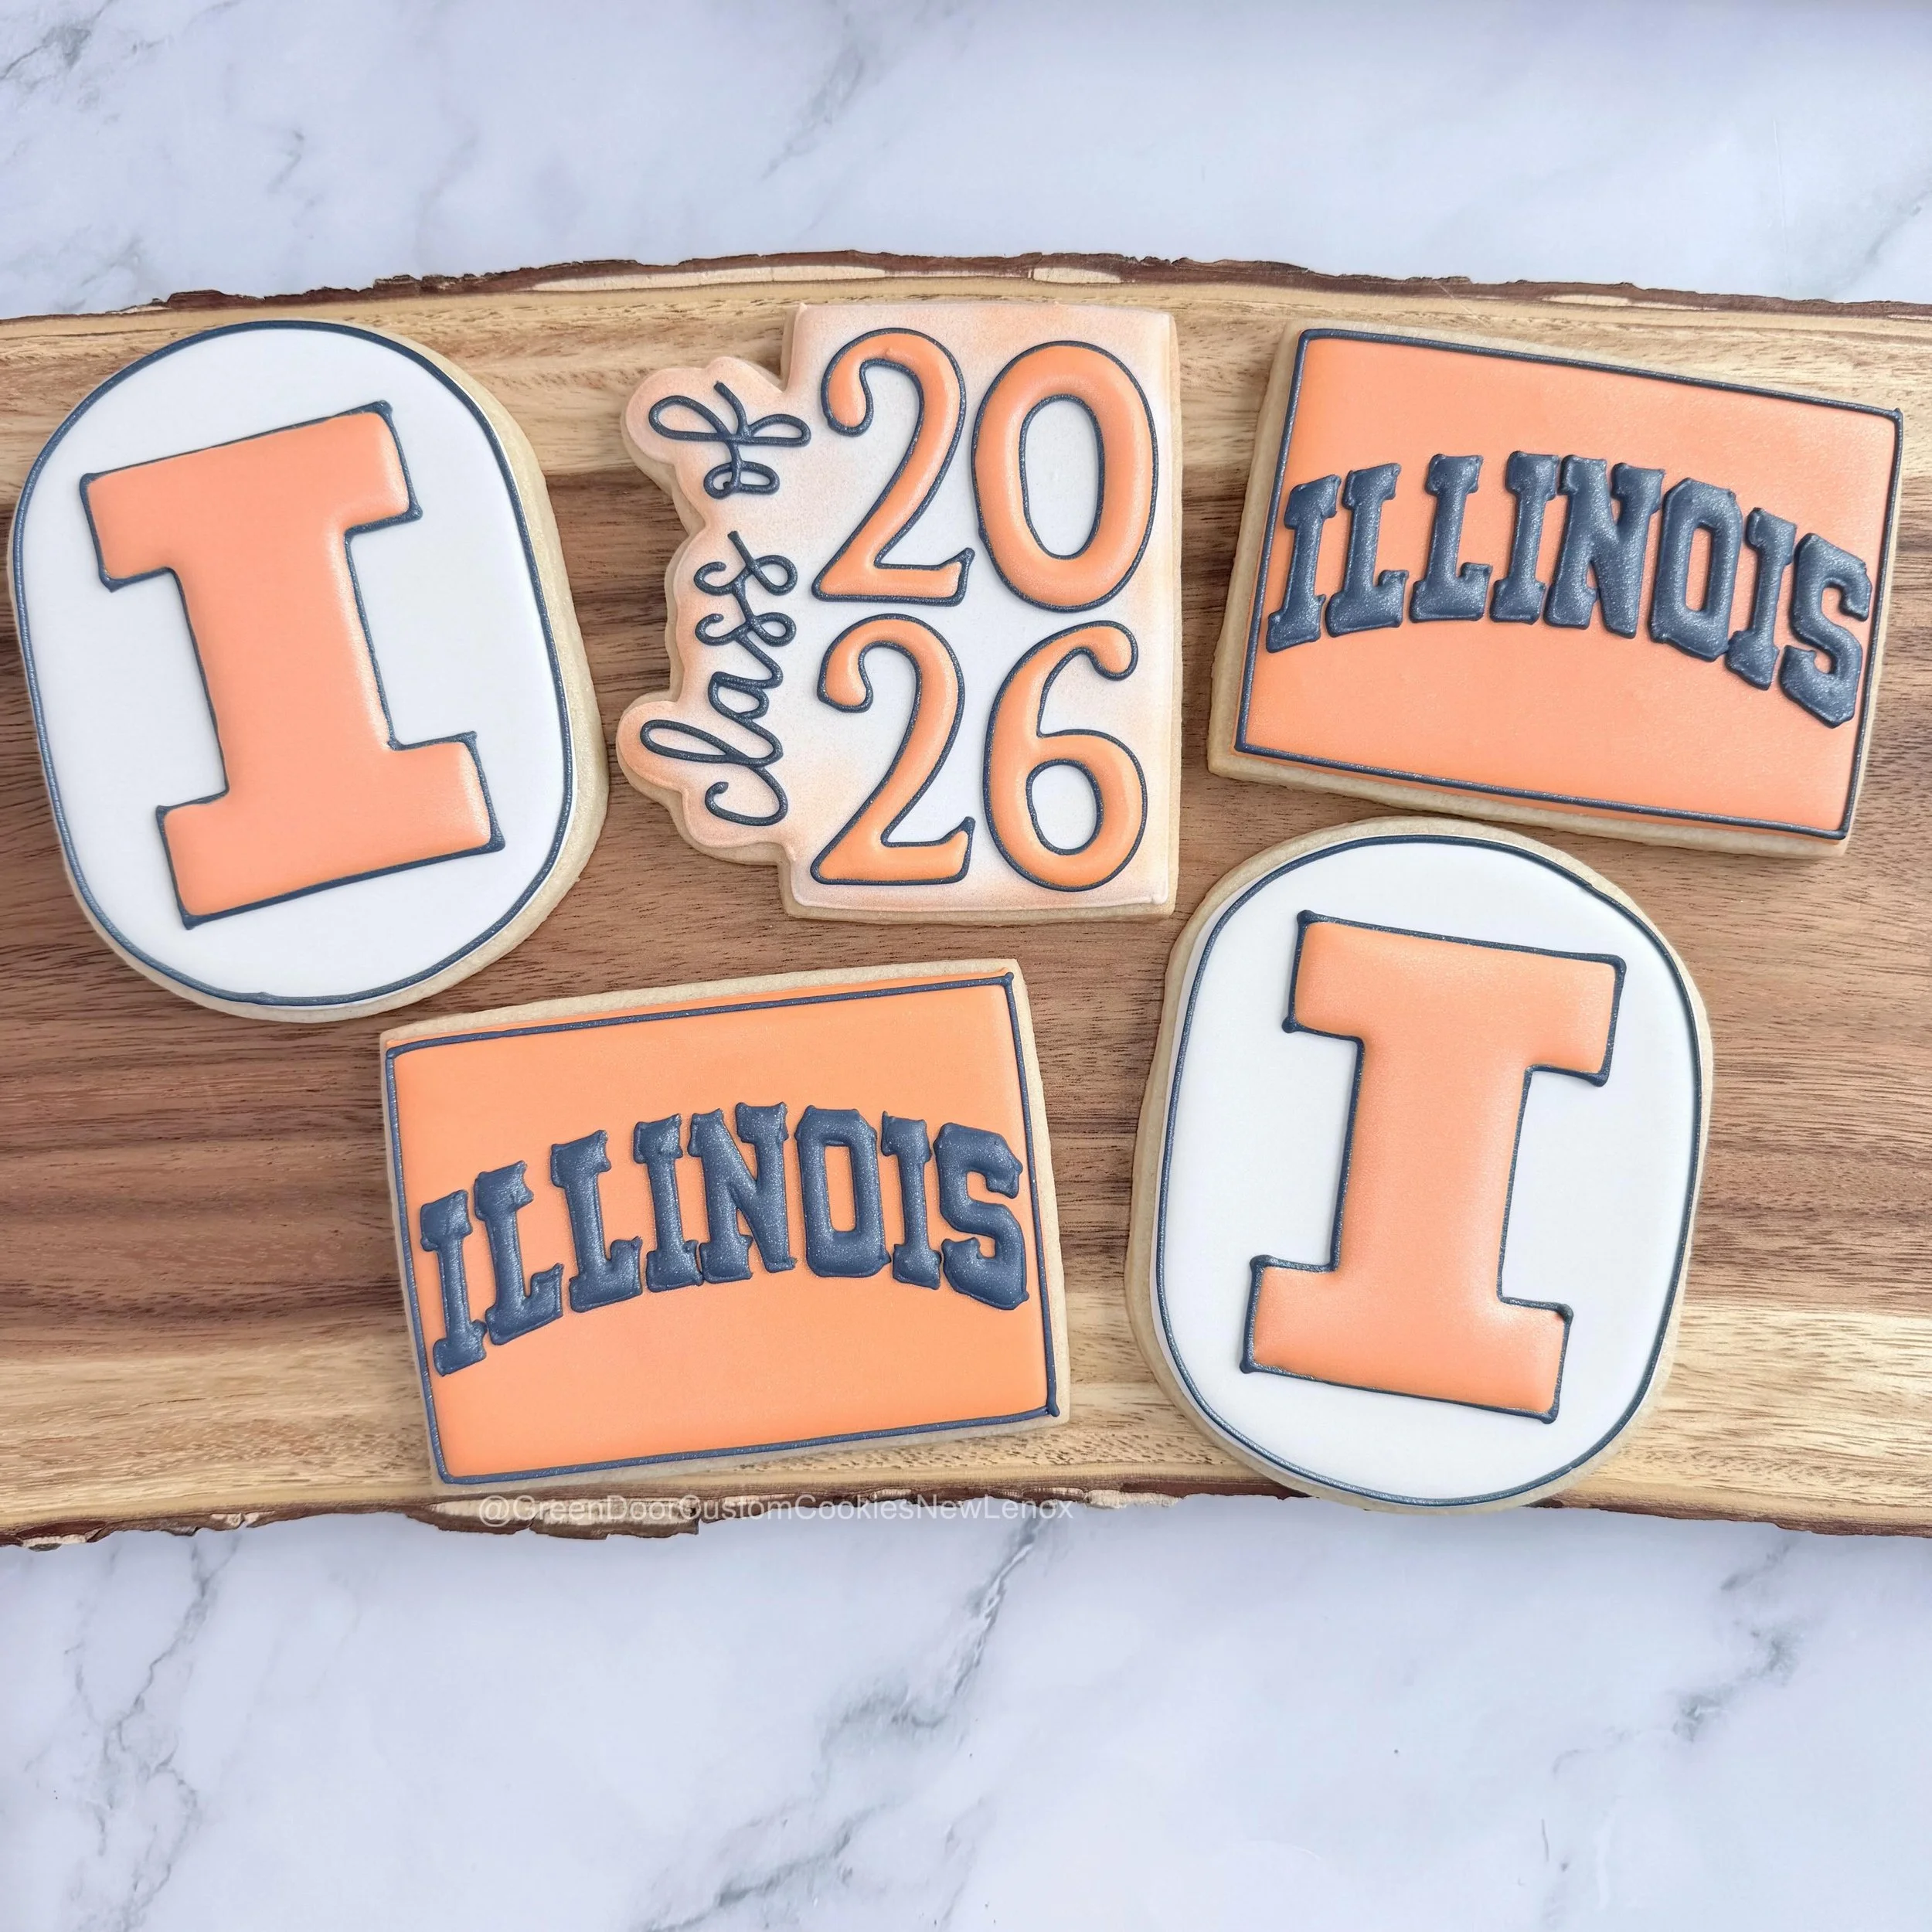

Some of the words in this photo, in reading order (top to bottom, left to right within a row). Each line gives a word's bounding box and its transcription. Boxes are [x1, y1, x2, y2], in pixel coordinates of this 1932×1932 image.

[648, 381, 811, 499] of
[811, 327, 1158, 613] 20
[79, 400, 505, 930] I
[640, 530, 798, 826] class
[1265, 451, 1872, 728] ILLINOIS
[810, 614, 1148, 892] 26
[420, 1101, 1029, 1376] ILLINOIS
[1239, 910, 1627, 1423] I
